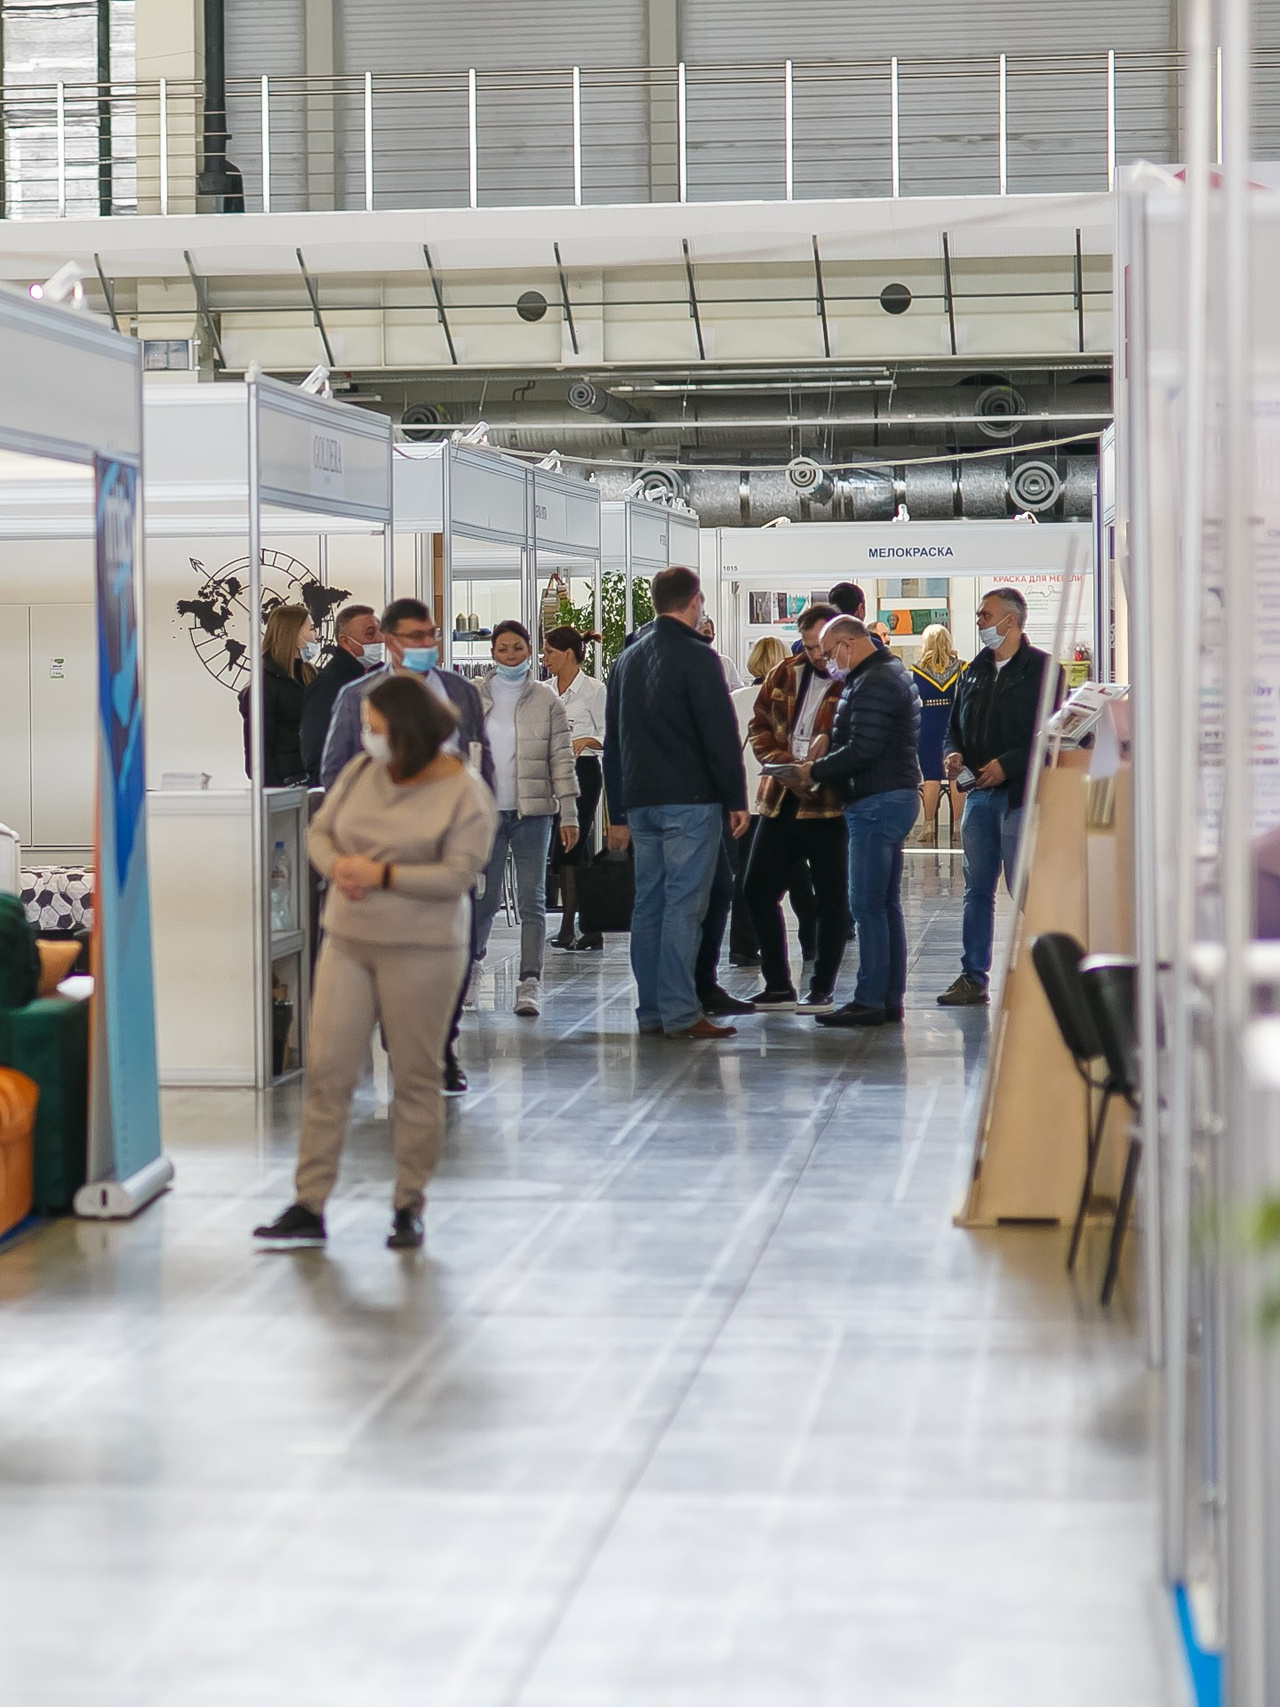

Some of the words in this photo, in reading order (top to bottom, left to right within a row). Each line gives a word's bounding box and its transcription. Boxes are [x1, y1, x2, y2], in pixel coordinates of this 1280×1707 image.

[868, 546, 954, 558] МЕЛОКРАСКА
[993, 575, 1027, 583] КРАСКА
[1028, 575, 1047, 583] ДЛЯ
